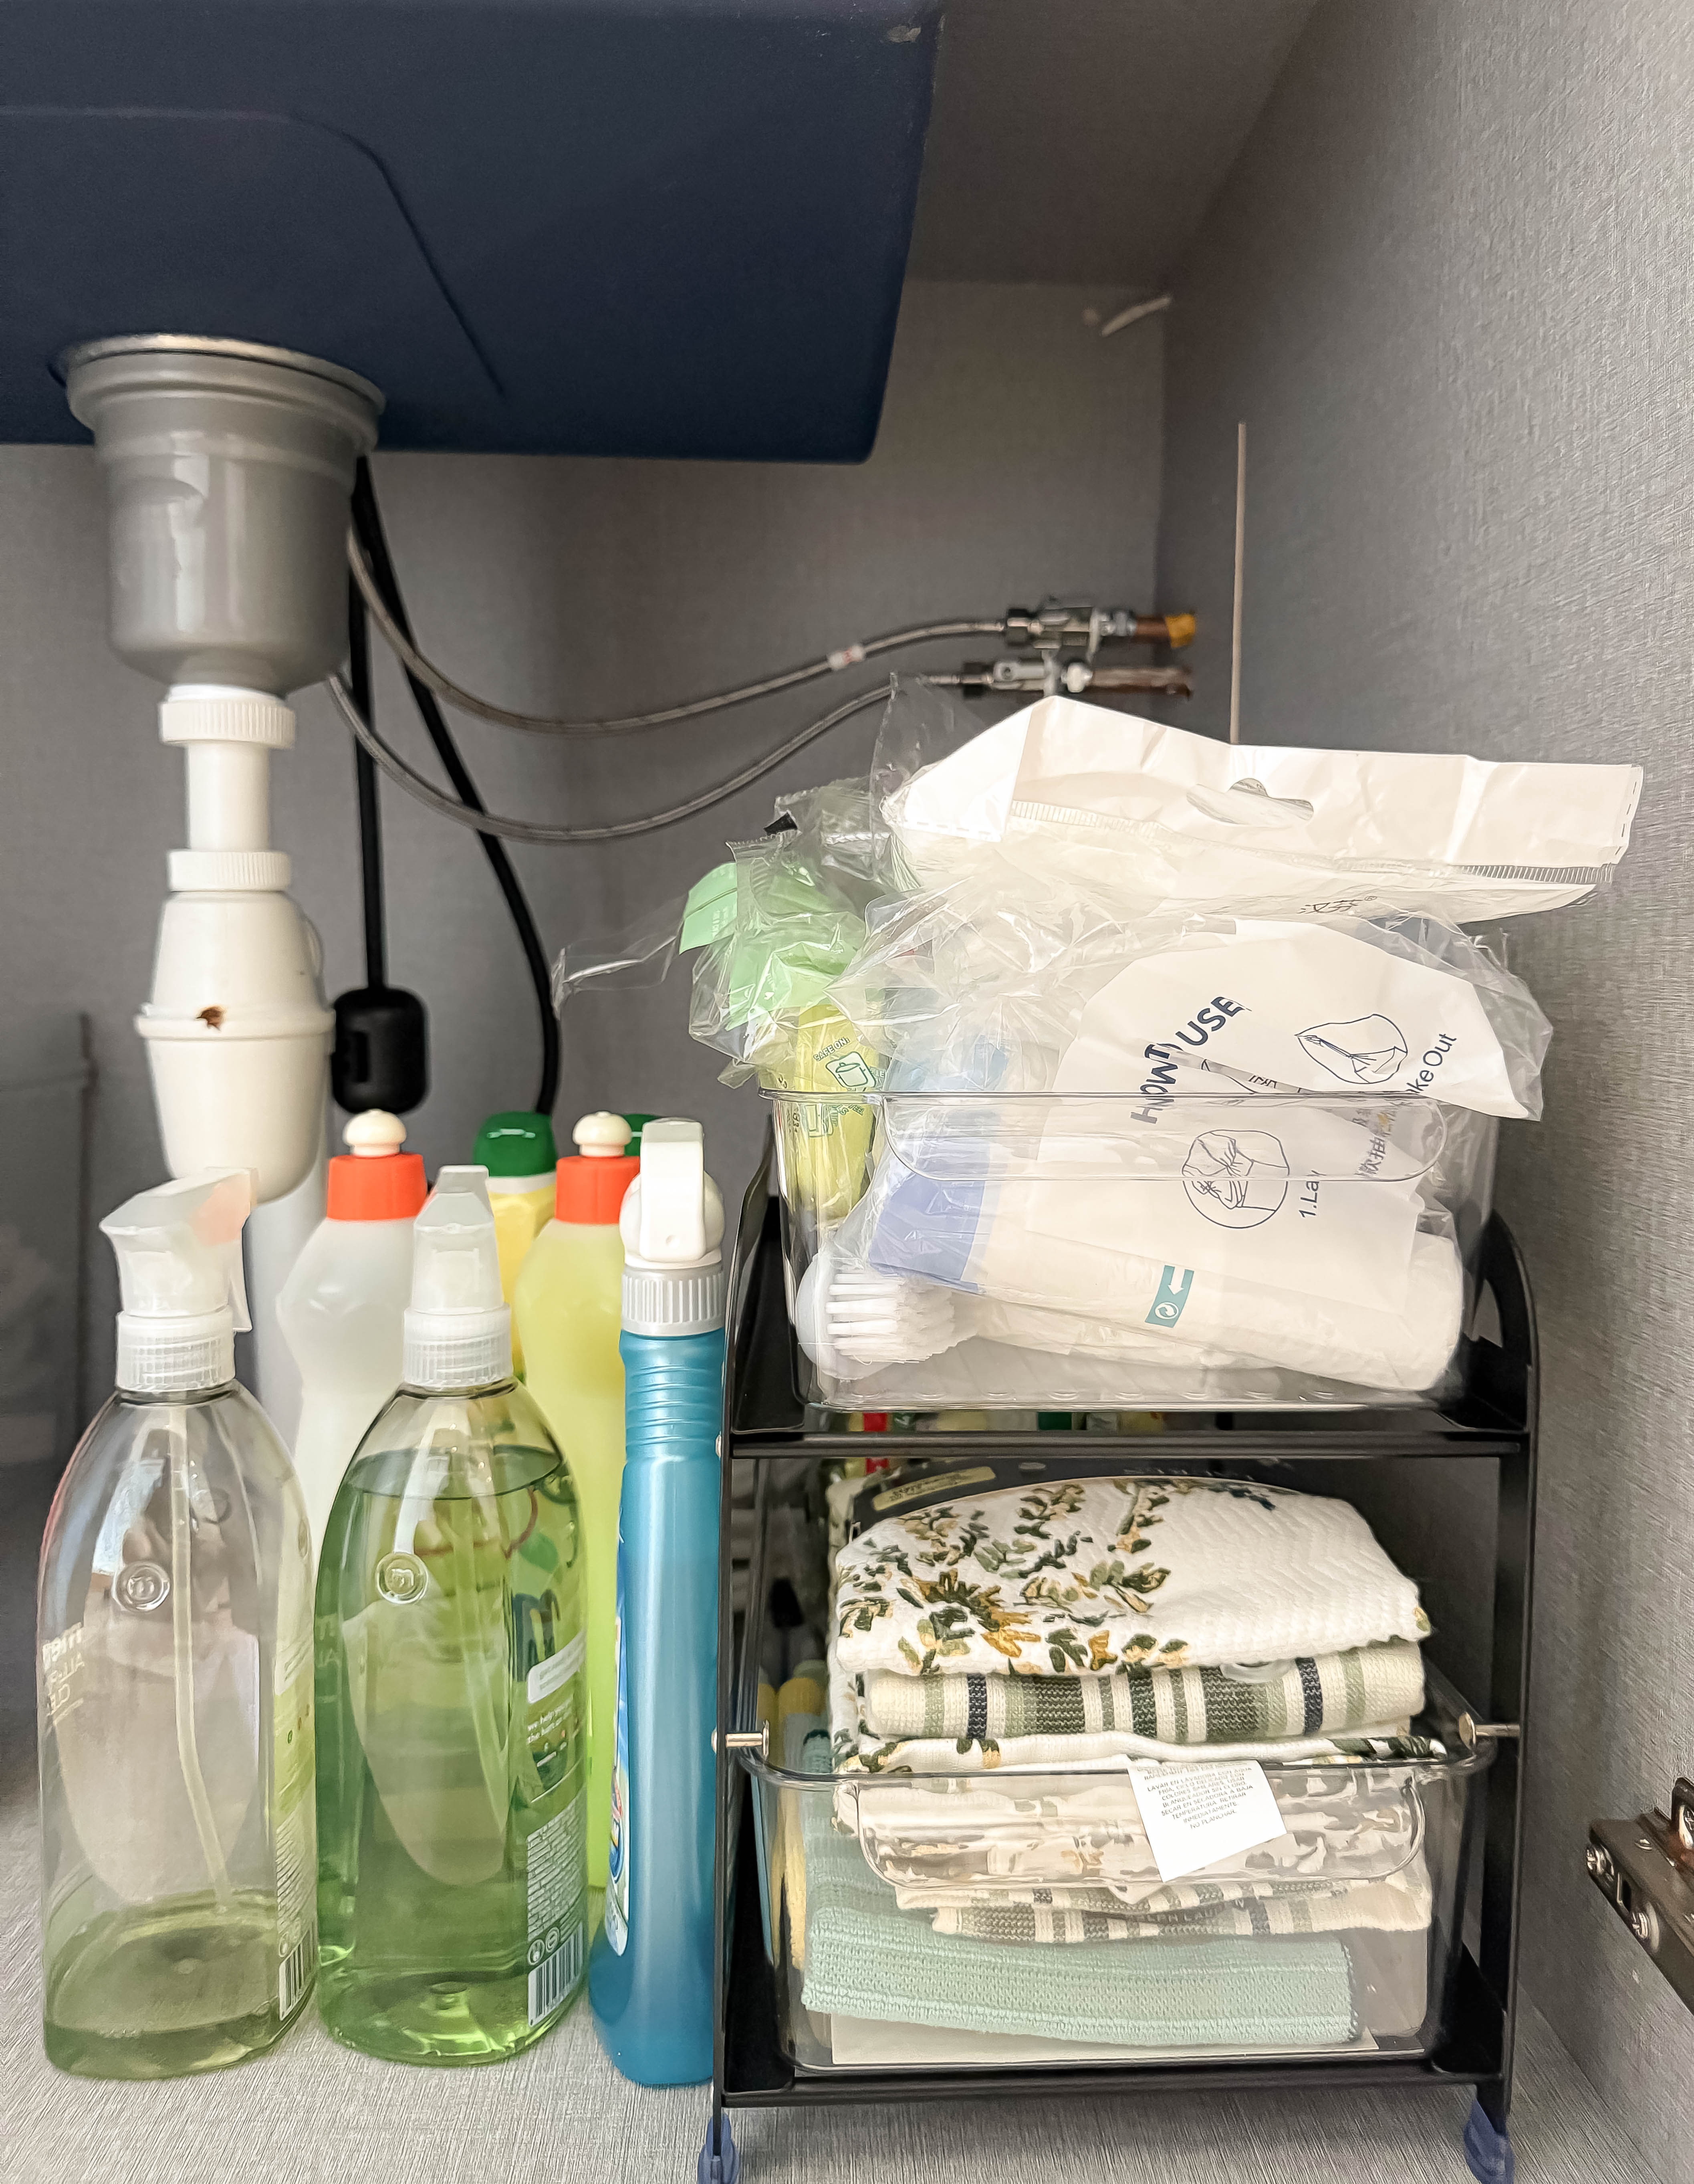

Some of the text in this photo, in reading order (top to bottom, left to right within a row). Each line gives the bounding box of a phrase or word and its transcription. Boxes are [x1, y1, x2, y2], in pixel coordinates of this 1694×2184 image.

[1175, 996, 1247, 1046] USE
[813, 1043, 836, 1061] SAFE
[1423, 1033, 1457, 1067] Out
[1147, 1782, 1169, 1792] LAVAR
[1161, 1804, 1182, 1816] SECAR
[1193, 1791, 1228, 1805] SECADORA
[1236, 1785, 1254, 1793] BAJA
[1220, 1792, 1246, 1803] RETIRAR
[1190, 1821, 1200, 1829] NO
